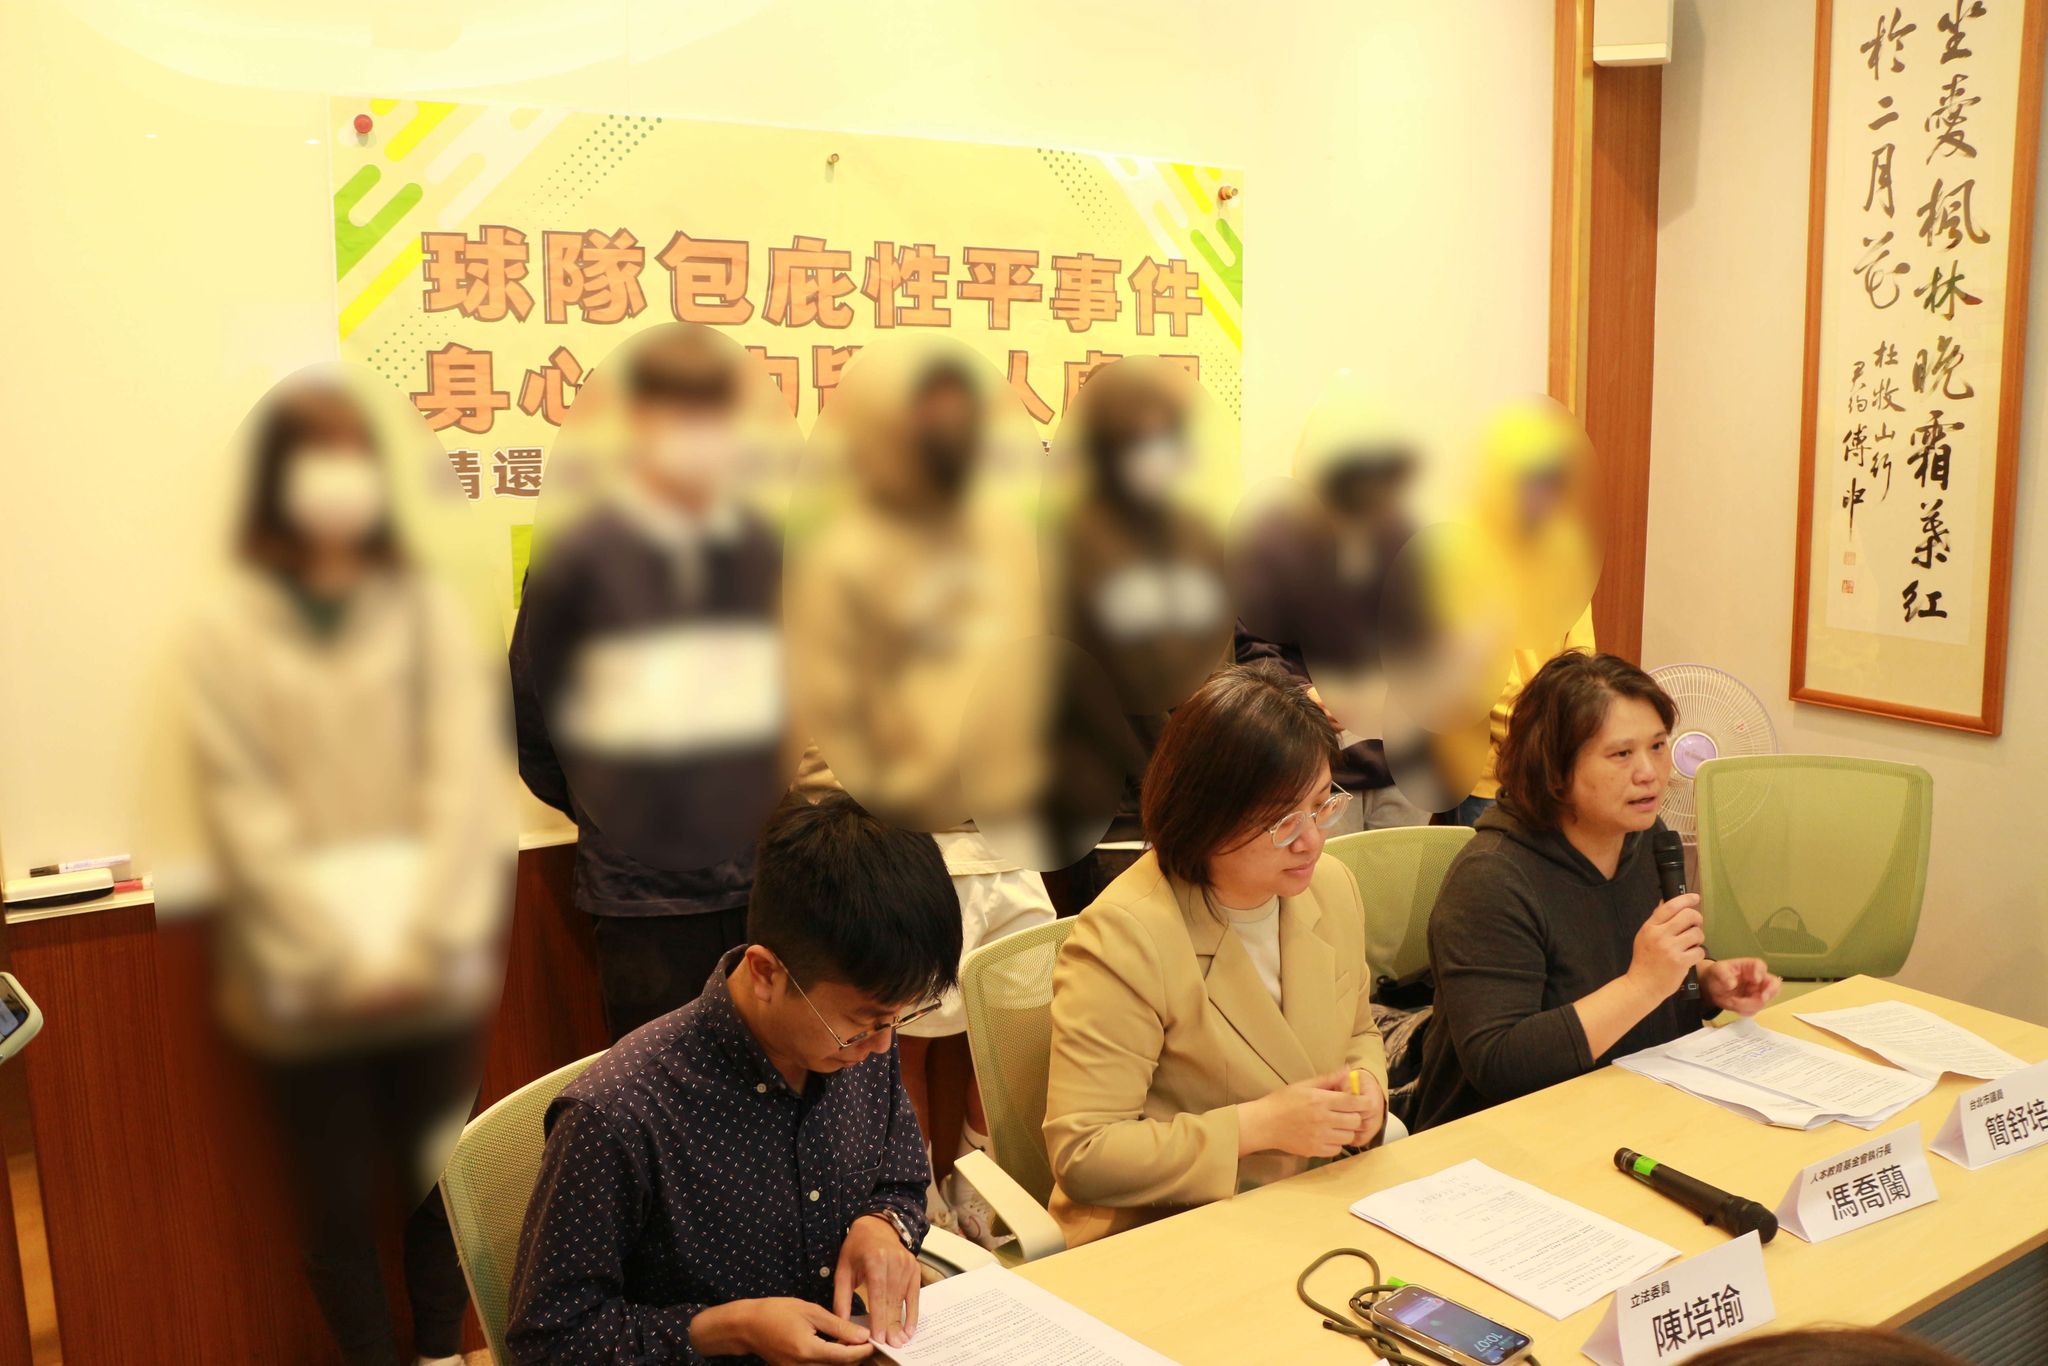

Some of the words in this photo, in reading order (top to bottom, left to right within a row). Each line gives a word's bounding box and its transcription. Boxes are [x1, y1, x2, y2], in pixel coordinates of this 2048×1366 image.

[421, 224, 1203, 338] 球隊包庇性平事件
[1985, 1099, 2048, 1150] 簡舒培
[1826, 1164, 1911, 1221] 馮喬蘭
[1631, 1280, 1671, 1309] 立法委員
[1652, 1284, 1744, 1358] 陳培瑜
[1473, 1332, 1503, 1352] 10:07
